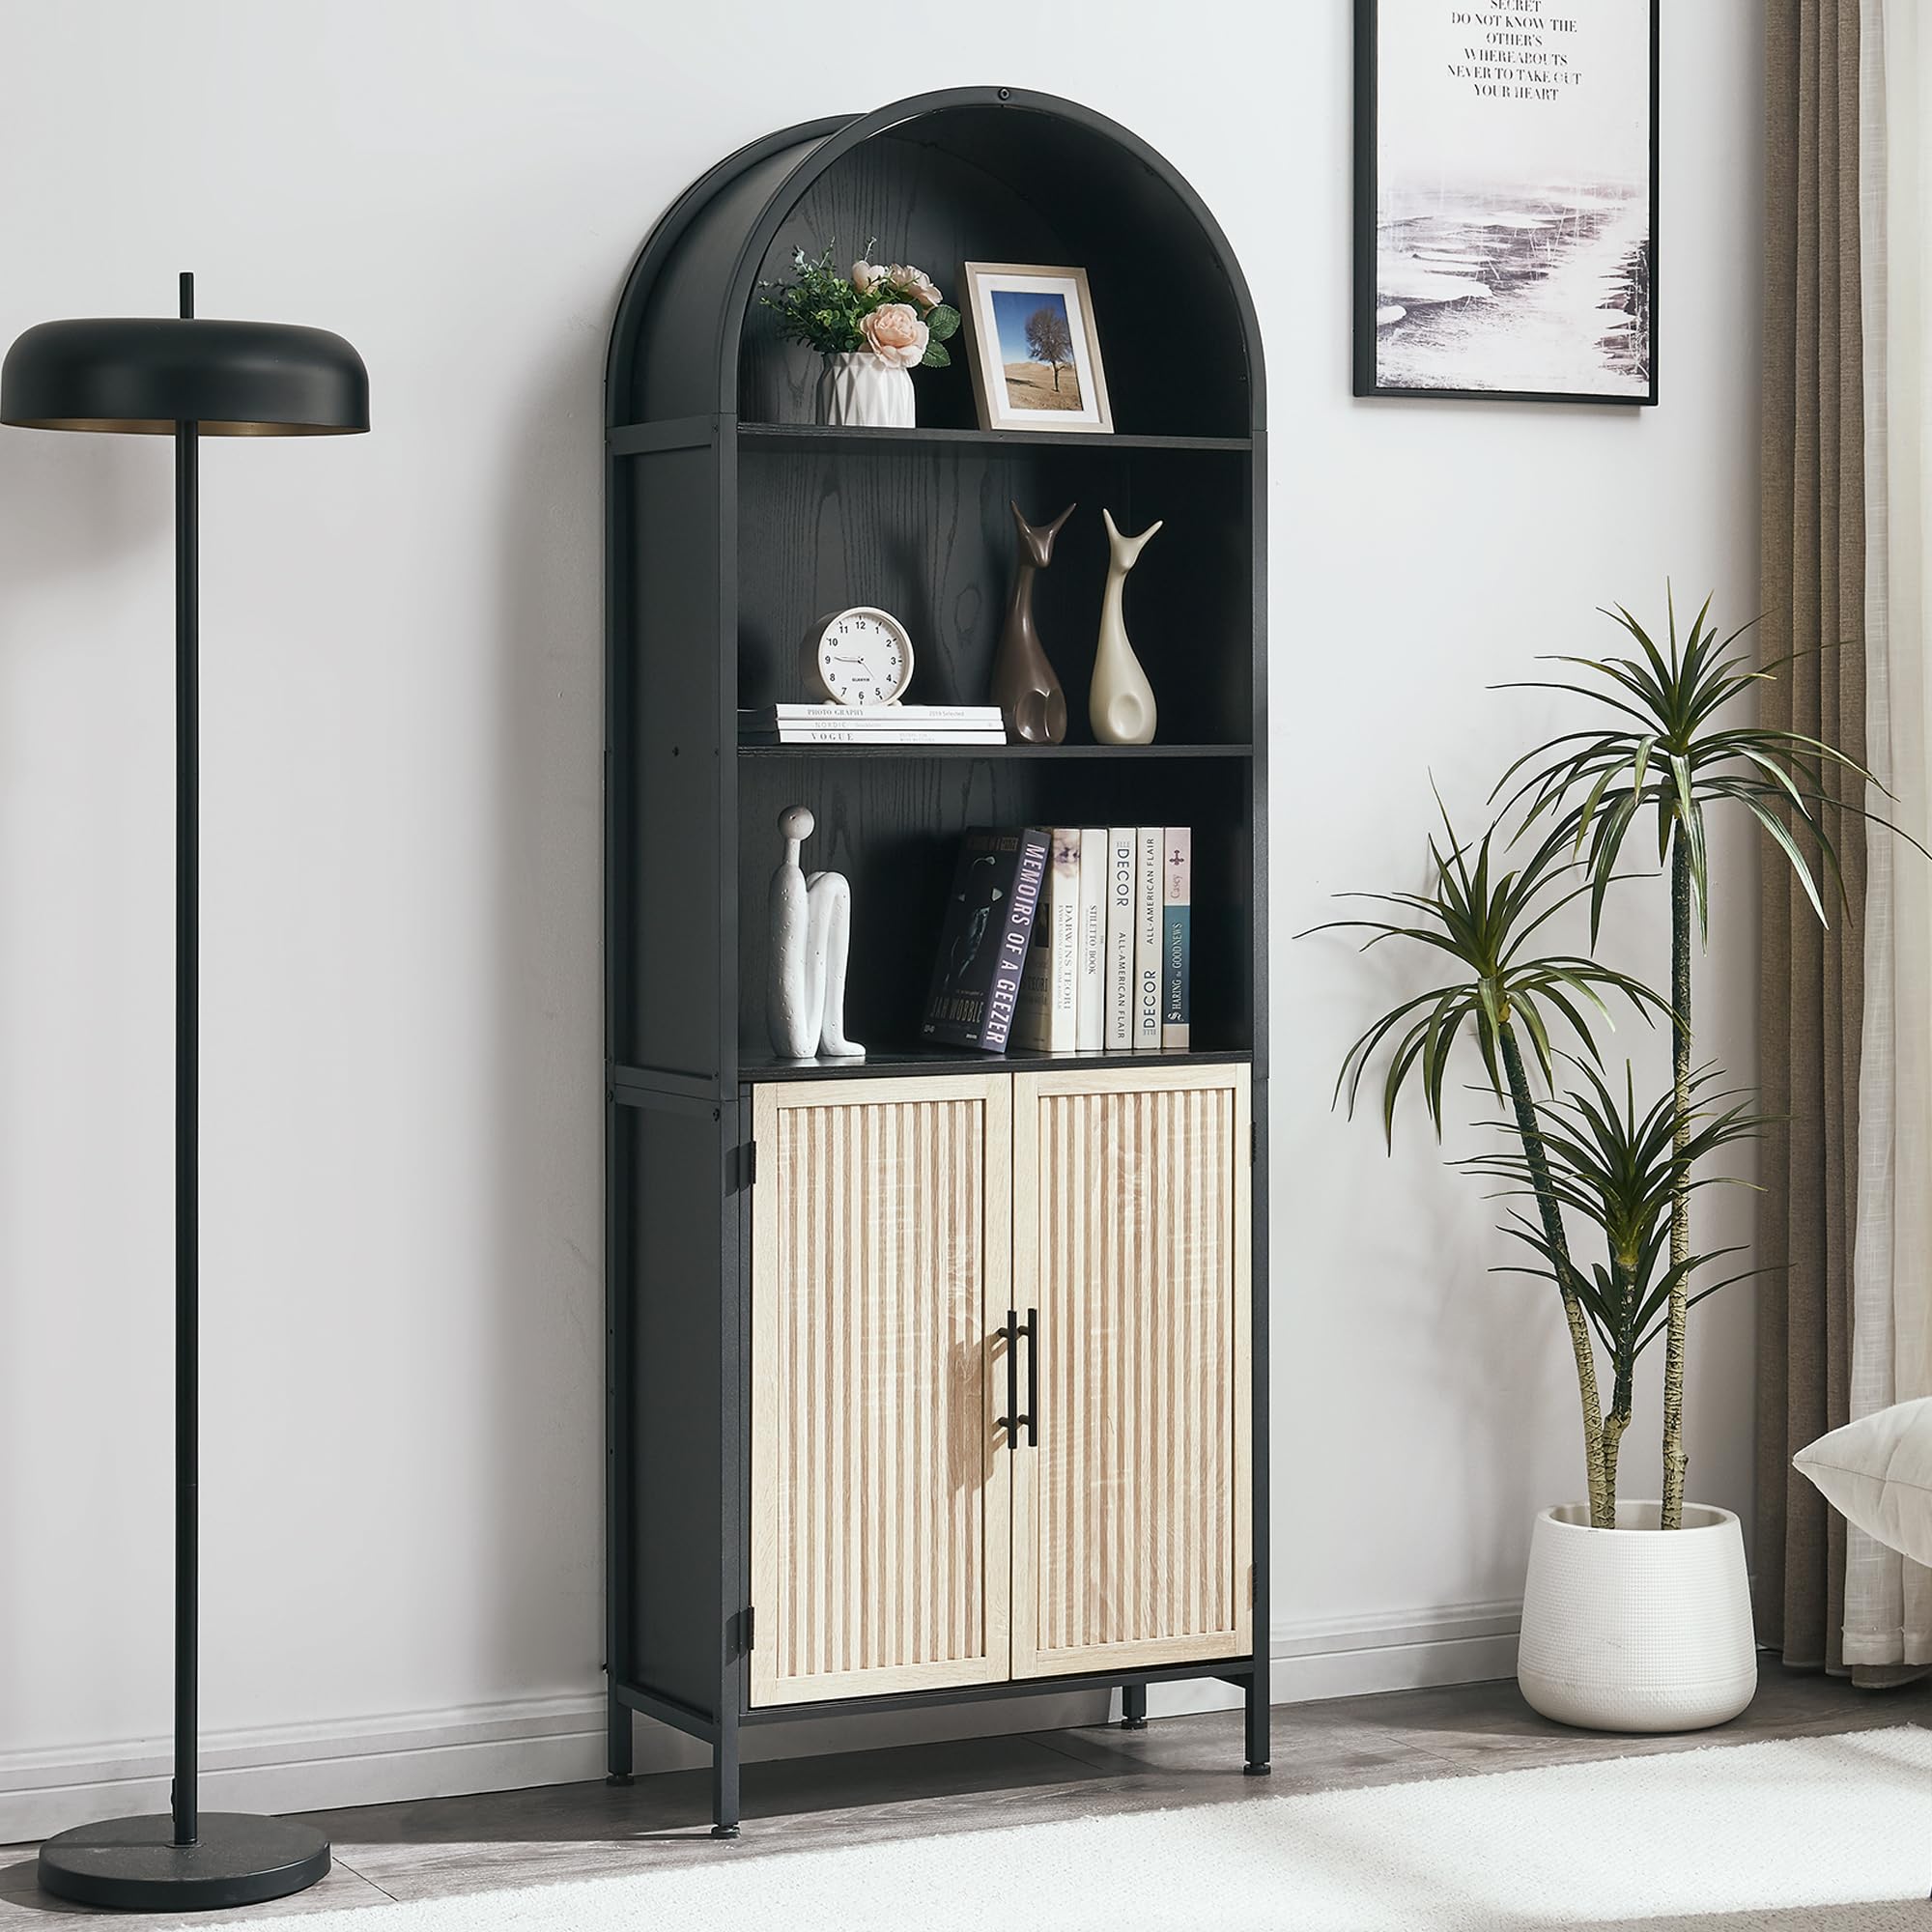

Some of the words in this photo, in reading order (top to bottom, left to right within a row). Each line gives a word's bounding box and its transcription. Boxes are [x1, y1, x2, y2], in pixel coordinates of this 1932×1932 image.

[1491, 0, 1542, 12] SECRET
[1452, 12, 1471, 24] DO
[1475, 14, 1502, 27] NOT
[1505, 16, 1544, 29] KNOW
[1550, 19, 1577, 32] THE
[1486, 32, 1543, 46] OTHER'S
[1464, 48, 1568, 66] WHEREABOUTS
[1448, 64, 1491, 79] NEVER
[1494, 67, 1513, 80] TO
[1517, 69, 1550, 83] TAKE
[1474, 84, 1510, 98] YOUR
[1515, 86, 1559, 101] HEART
[856, 621, 866, 629] 12
[828, 638, 838, 646] 10
[886, 639, 892, 647] 2
[825, 655, 831, 664] 9
[891, 657, 896, 665] 3
[829, 673, 835, 682] 8
[841, 687, 847, 696] 7
[858, 691, 864, 699] 6
[875, 687, 881, 696] 5
[1011, 843, 1045, 926] MEMOIRS
[1116, 849, 1130, 907] DECOR
[1170, 875, 1183, 899] Casey
[1146, 870, 1154, 945] ALL-AMERICAN
[1065, 905, 1073, 966] DARWINS
[1089, 905, 1098, 946] STILETTO
[1171, 923, 1182, 945] NEWS
[1006, 932, 1025, 955] OF
[1001, 960, 1019, 971] A
[1088, 951, 1097, 975] BOOK
[1172, 946, 1182, 969] GOOD
[1118, 932, 1126, 1007] ALL-AMERICAN
[1063, 970, 1072, 1009] TEORI
[1143, 970, 1156, 1028] DECOR
[986, 979, 1016, 1044] GEEZER
[1117, 1010, 1125, 1039] FLAIR
